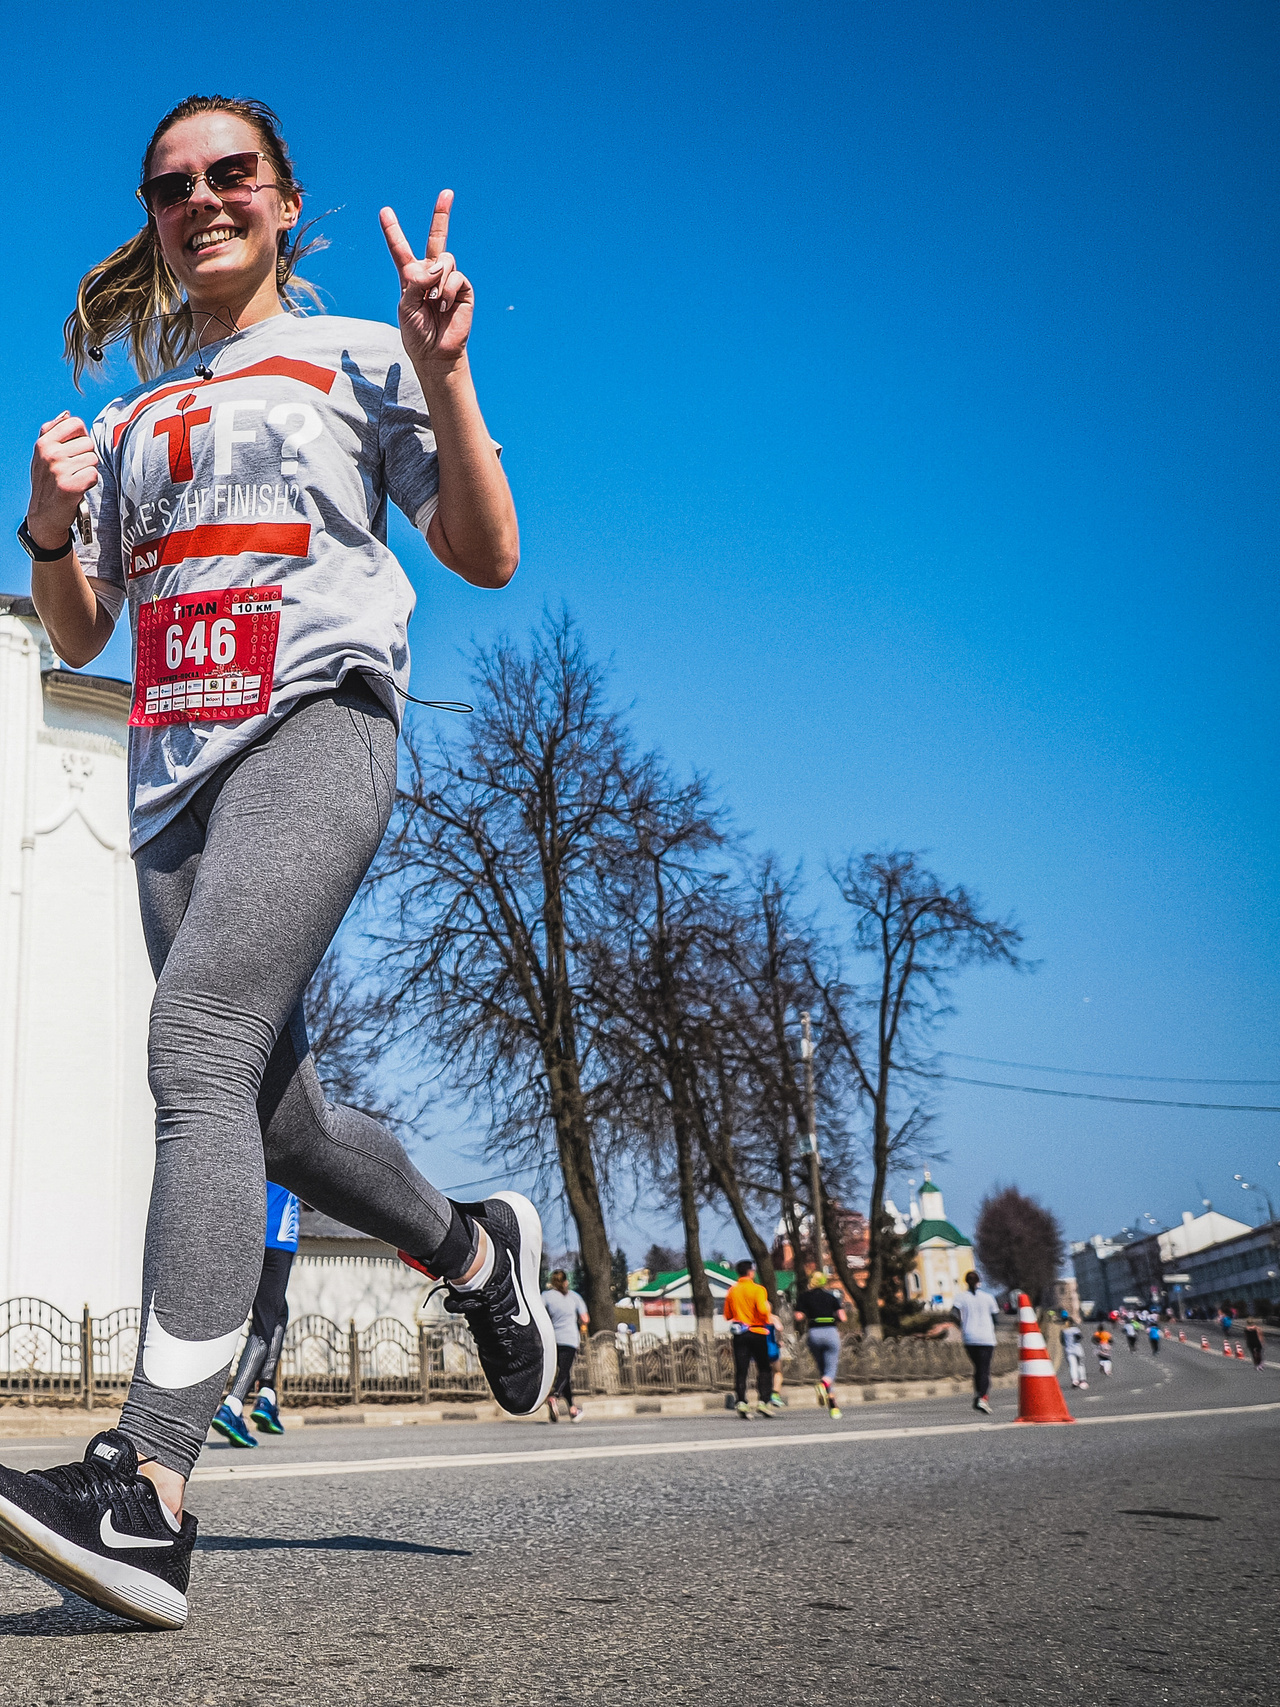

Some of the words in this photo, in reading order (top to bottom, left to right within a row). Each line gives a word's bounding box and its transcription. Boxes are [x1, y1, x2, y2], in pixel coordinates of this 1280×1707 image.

[214, 484, 300, 517] FINISH?
[238, 603, 252, 613] 10
[166, 618, 236, 669] 646
[93, 1442, 120, 1460] NIKE
